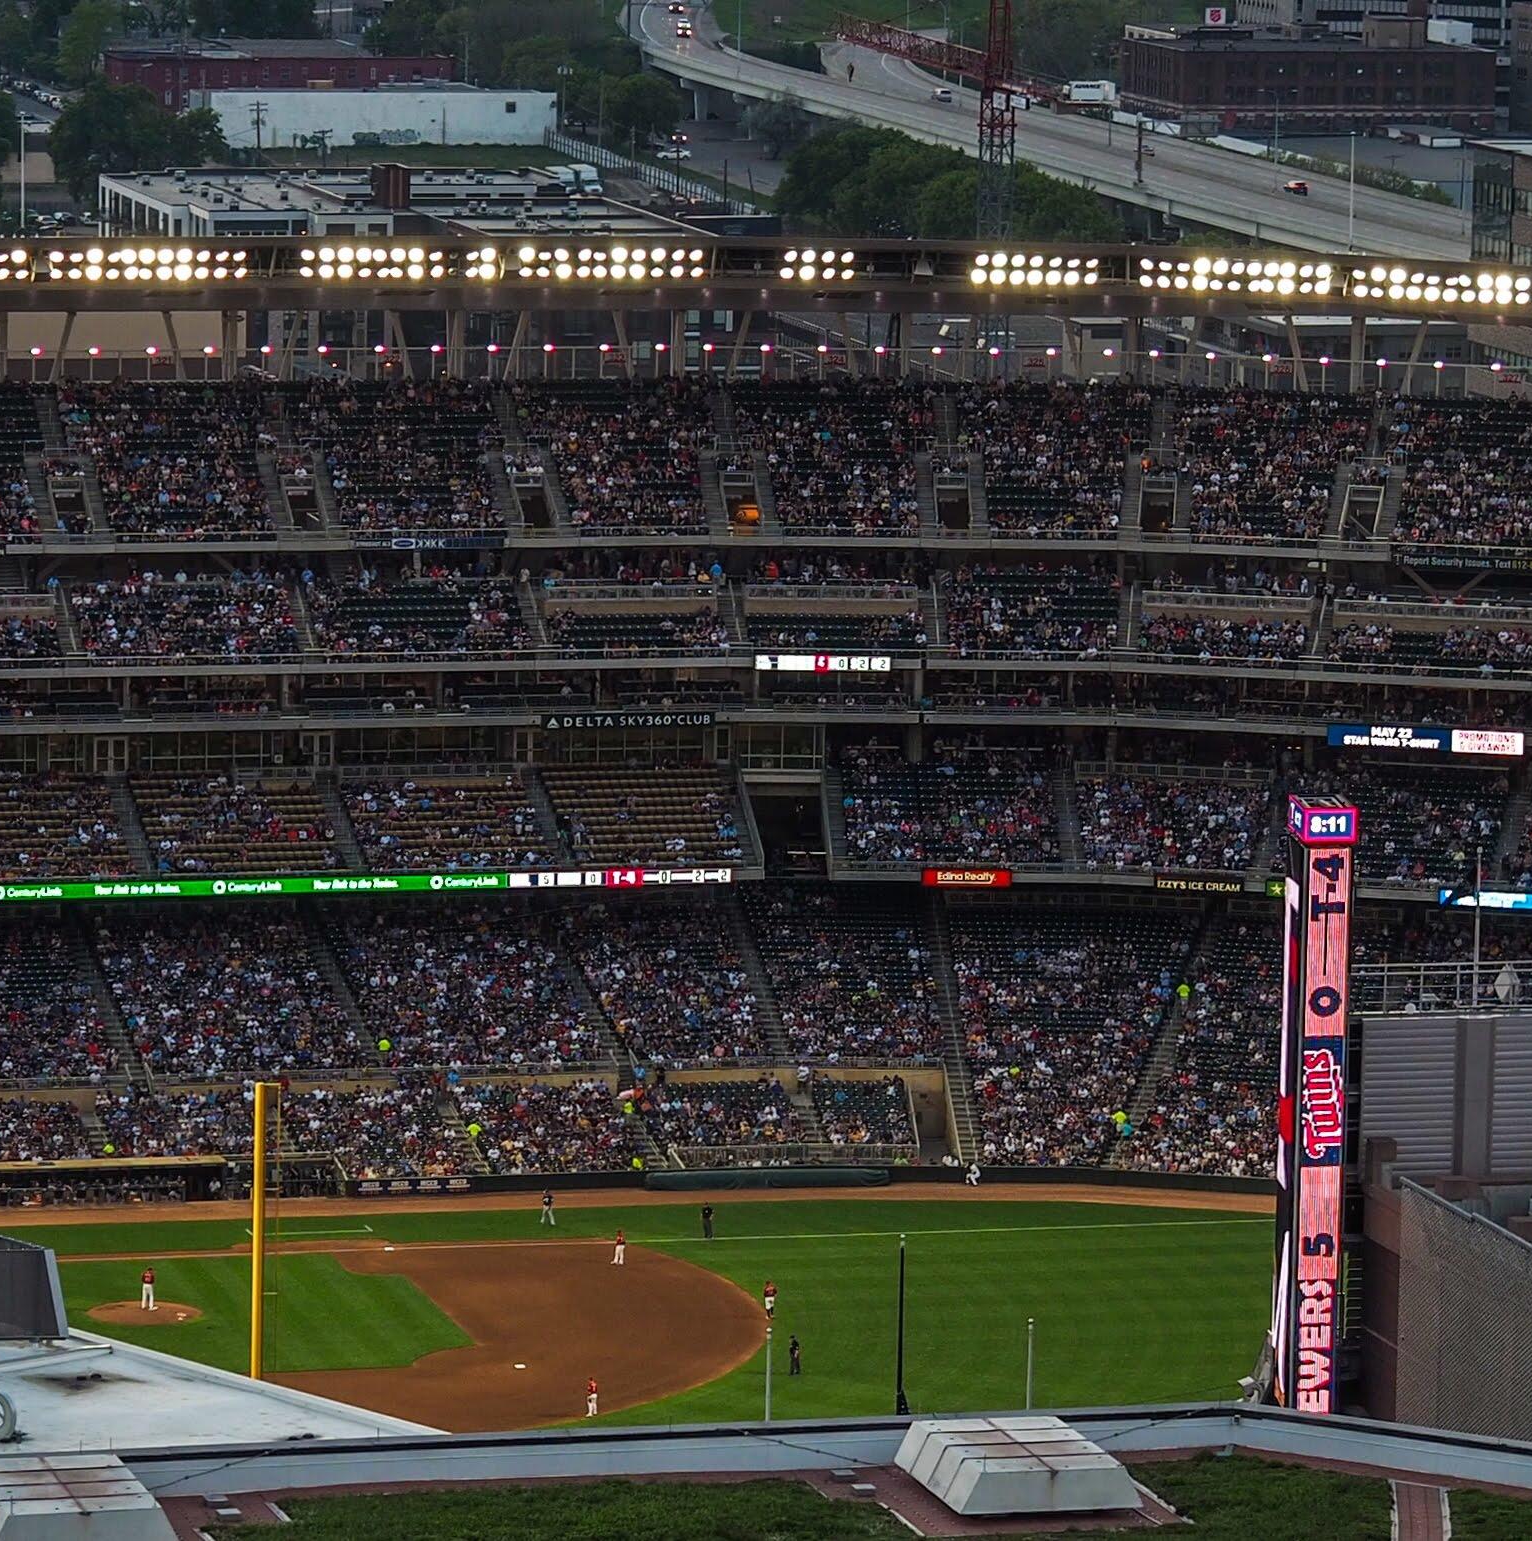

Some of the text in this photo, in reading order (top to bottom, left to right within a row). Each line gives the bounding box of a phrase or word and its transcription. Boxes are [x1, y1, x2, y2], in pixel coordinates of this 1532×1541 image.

[1404, 552, 1430, 566] Report
[1431, 556, 1464, 568] Security
[1494, 559, 1511, 570] Text
[563, 716, 614, 728] DELTA
[1370, 726, 1414, 739] MAY 22
[1458, 732, 1517, 745] PROMOTIONS
[1343, 734, 1370, 746] STAR
[1310, 815, 1348, 834] 8:11
[444, 875, 499, 888] CenturyLink
[936, 871, 964, 881] Edina
[6, 887, 64, 898] CenturyLink
[228, 880, 283, 893] CenturyLink
[1156, 880, 1241, 893] IZZY'S ICE CREAM
[1301, 1047, 1342, 1160] Twins
